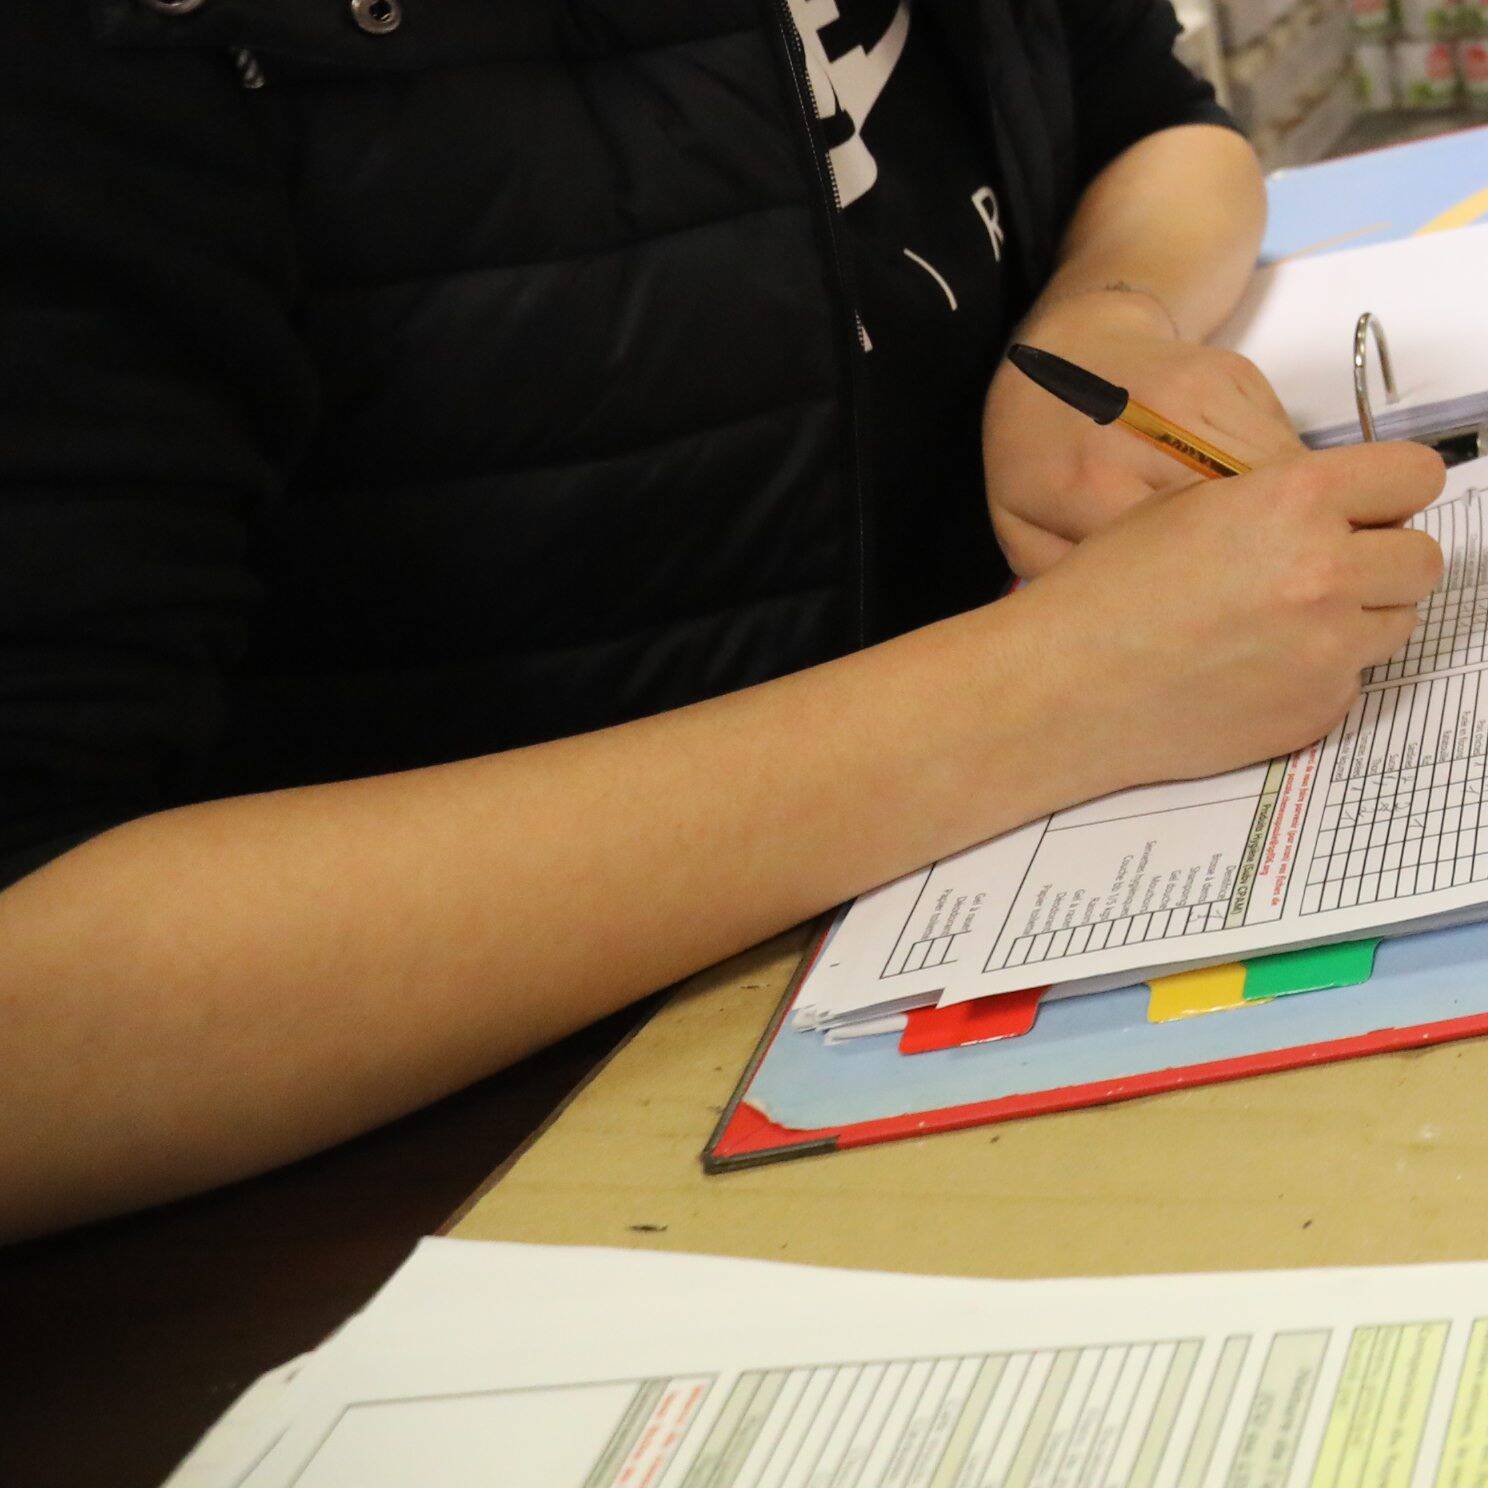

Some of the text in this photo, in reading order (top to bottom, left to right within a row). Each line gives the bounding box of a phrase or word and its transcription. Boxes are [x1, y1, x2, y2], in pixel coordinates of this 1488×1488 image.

[1255, 802, 1270, 832] Produits
[1244, 831, 1262, 863] Hygiène
[1114, 852, 1133, 883] Couche
[1197, 851, 1222, 904] Brosse dents
[1217, 862, 1236, 901] Dentifrice
[933, 885, 953, 914] Papier
[971, 890, 986, 906] Gel
[1033, 881, 1052, 908] Papier
[1072, 887, 1085, 902] Gel
[1158, 867, 1181, 911] Gel douche
[1175, 863, 1200, 909] Shampoing
[1230, 884, 1247, 916] CPAM)
